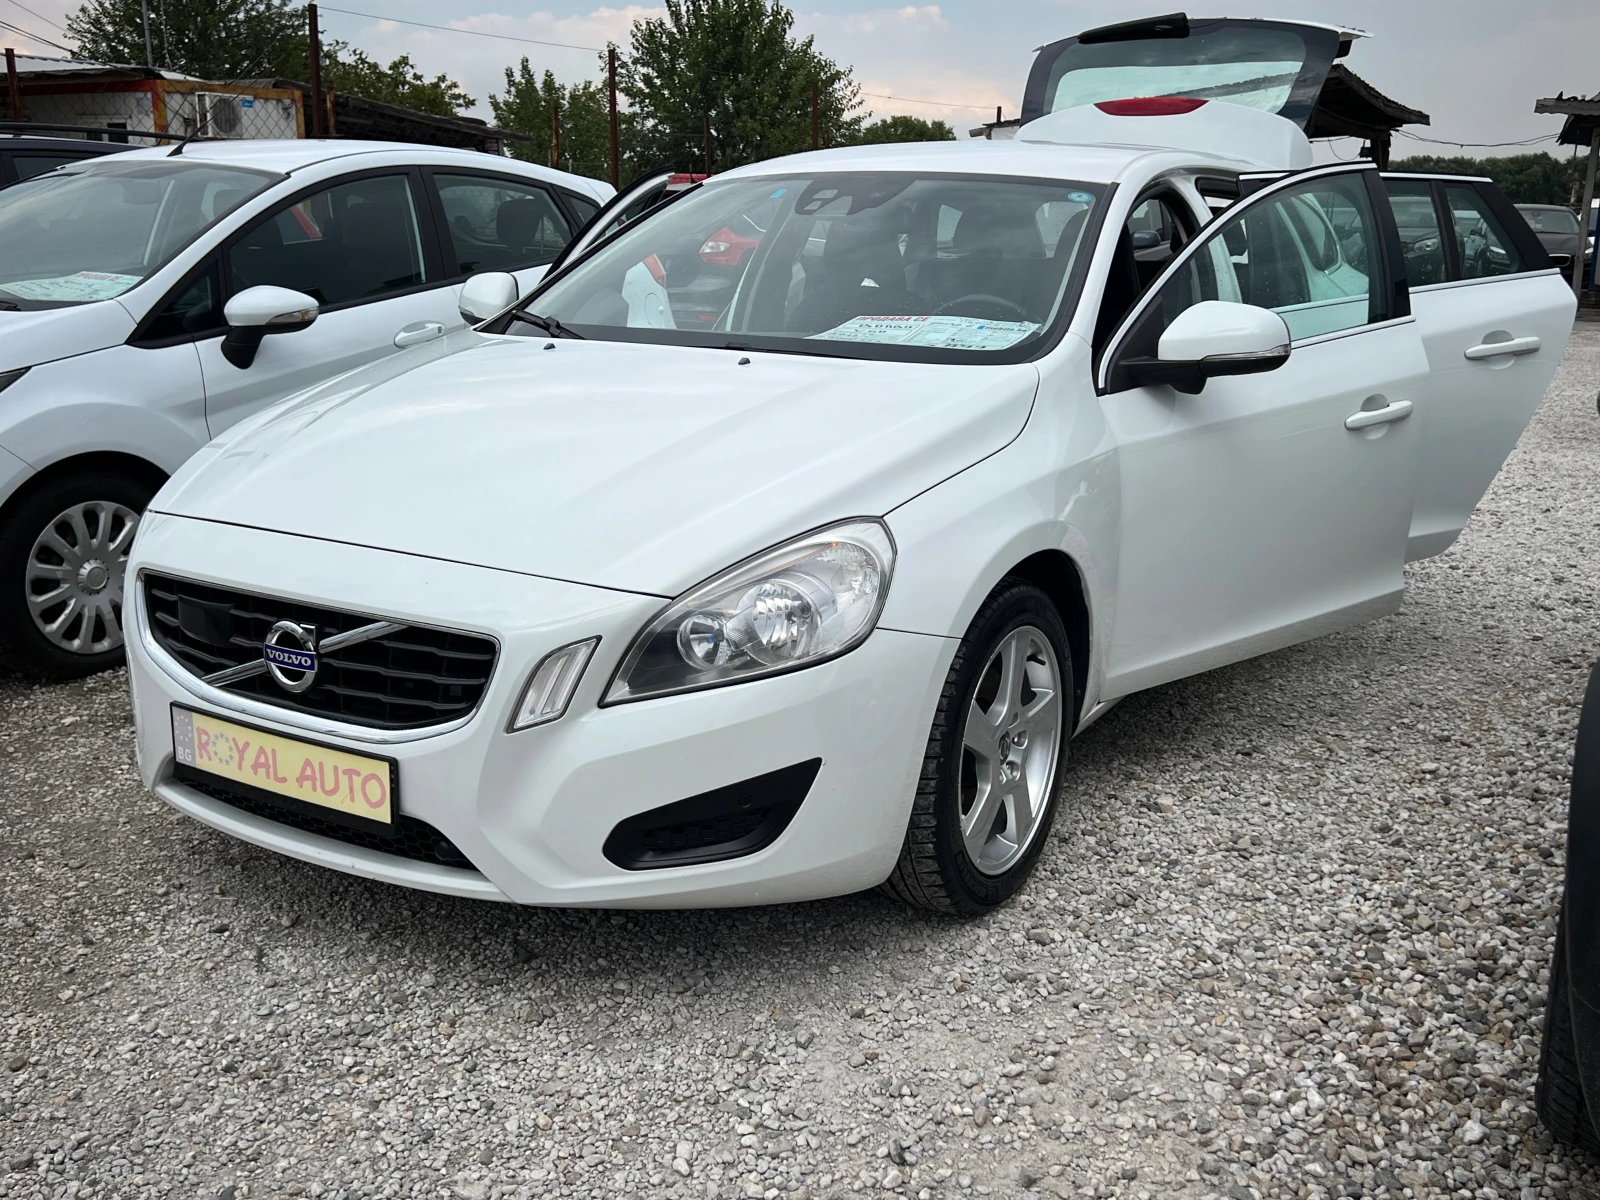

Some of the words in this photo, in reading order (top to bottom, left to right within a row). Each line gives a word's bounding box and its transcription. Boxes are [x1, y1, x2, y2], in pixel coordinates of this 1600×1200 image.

[266, 649, 311, 667] VOLVO
[178, 746, 192, 761] BG
[195, 727, 288, 784] ROYAL
[295, 758, 387, 809] AUTO
